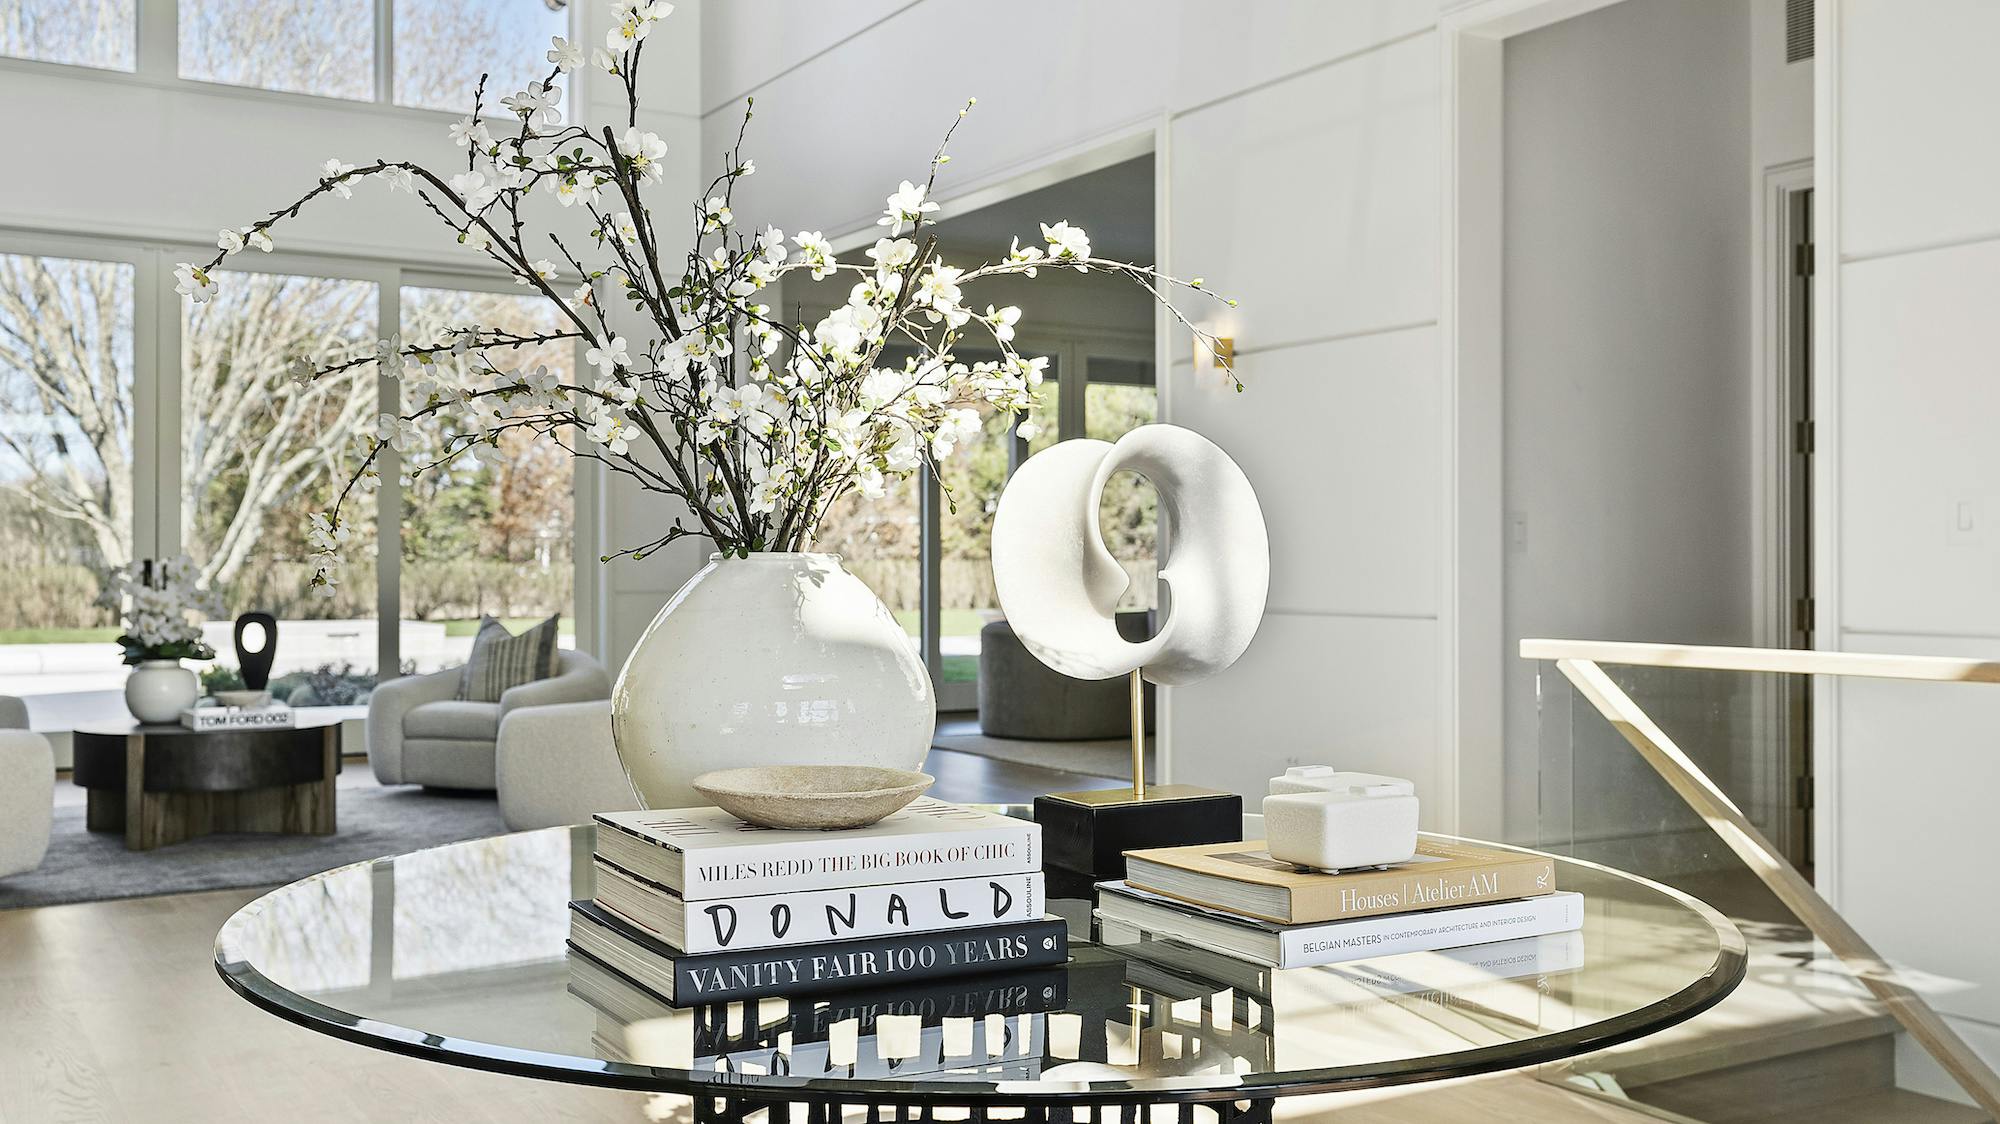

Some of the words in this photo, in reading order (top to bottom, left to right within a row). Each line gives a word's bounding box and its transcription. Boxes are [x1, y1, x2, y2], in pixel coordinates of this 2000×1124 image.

[200, 715, 226, 726] TOM
[229, 713, 264, 726] FORD
[265, 712, 288, 724] 002
[699, 862, 757, 883] MILES
[762, 859, 813, 878] REDD
[819, 855, 857, 873] THE
[862, 852, 890, 869] BIG
[896, 848, 944, 867] BOOK
[947, 847, 970, 862] OF
[974, 842, 1015, 860] CHIC
[1341, 888, 1399, 912] Houses
[1412, 878, 1464, 904] Atelier
[1468, 872, 1499, 897] AM
[704, 881, 1012, 947] DONALD
[1303, 939, 1341, 953] BELGIAN
[1343, 934, 1382, 948] MASTERS
[1384, 933, 1390, 941] IN
[1391, 928, 1437, 941] CONTEMPORARY
[1438, 922, 1479, 934] ARCHITECTURE
[1480, 920, 1492, 928] AND
[1492, 917, 1516, 926] INTERIOR
[1517, 915, 1537, 923] DESIGN
[687, 958, 803, 993] VANITY
[811, 951, 879, 981] FAIR
[885, 945, 936, 973] 100
[945, 935, 1029, 966] YEARS
